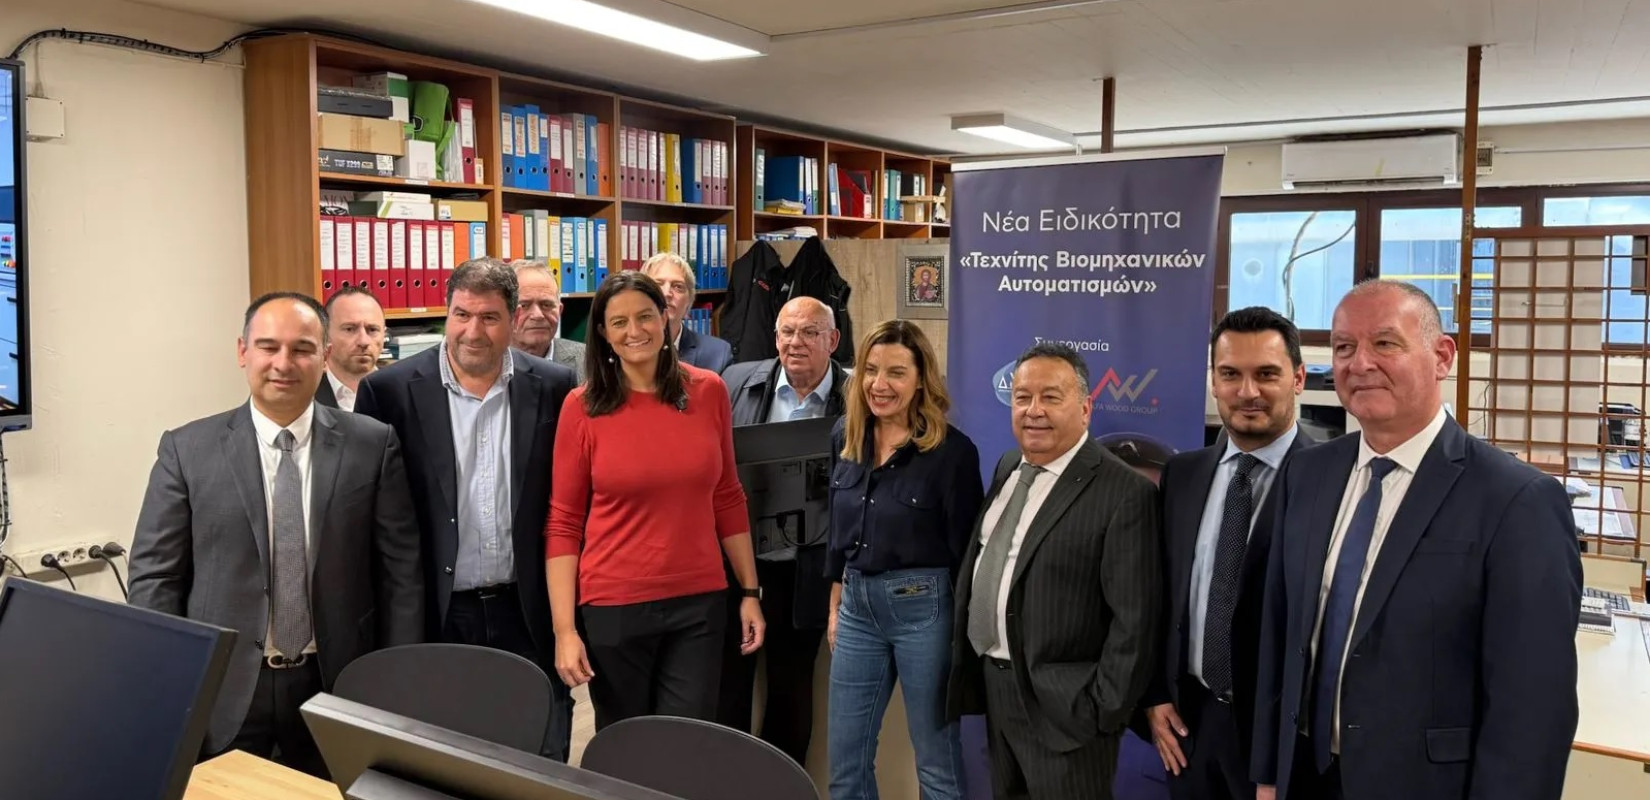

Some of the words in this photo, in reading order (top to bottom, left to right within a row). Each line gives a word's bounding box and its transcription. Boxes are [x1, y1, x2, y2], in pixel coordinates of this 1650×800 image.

[983, 210, 1030, 233] Νέα
[1040, 206, 1181, 234] Ειδικότητα
[960, 250, 1050, 272] «Τεχνίτης
[1056, 249, 1206, 272] Βιομηχανικών
[998, 274, 1157, 297] Αυτοματισμών»
